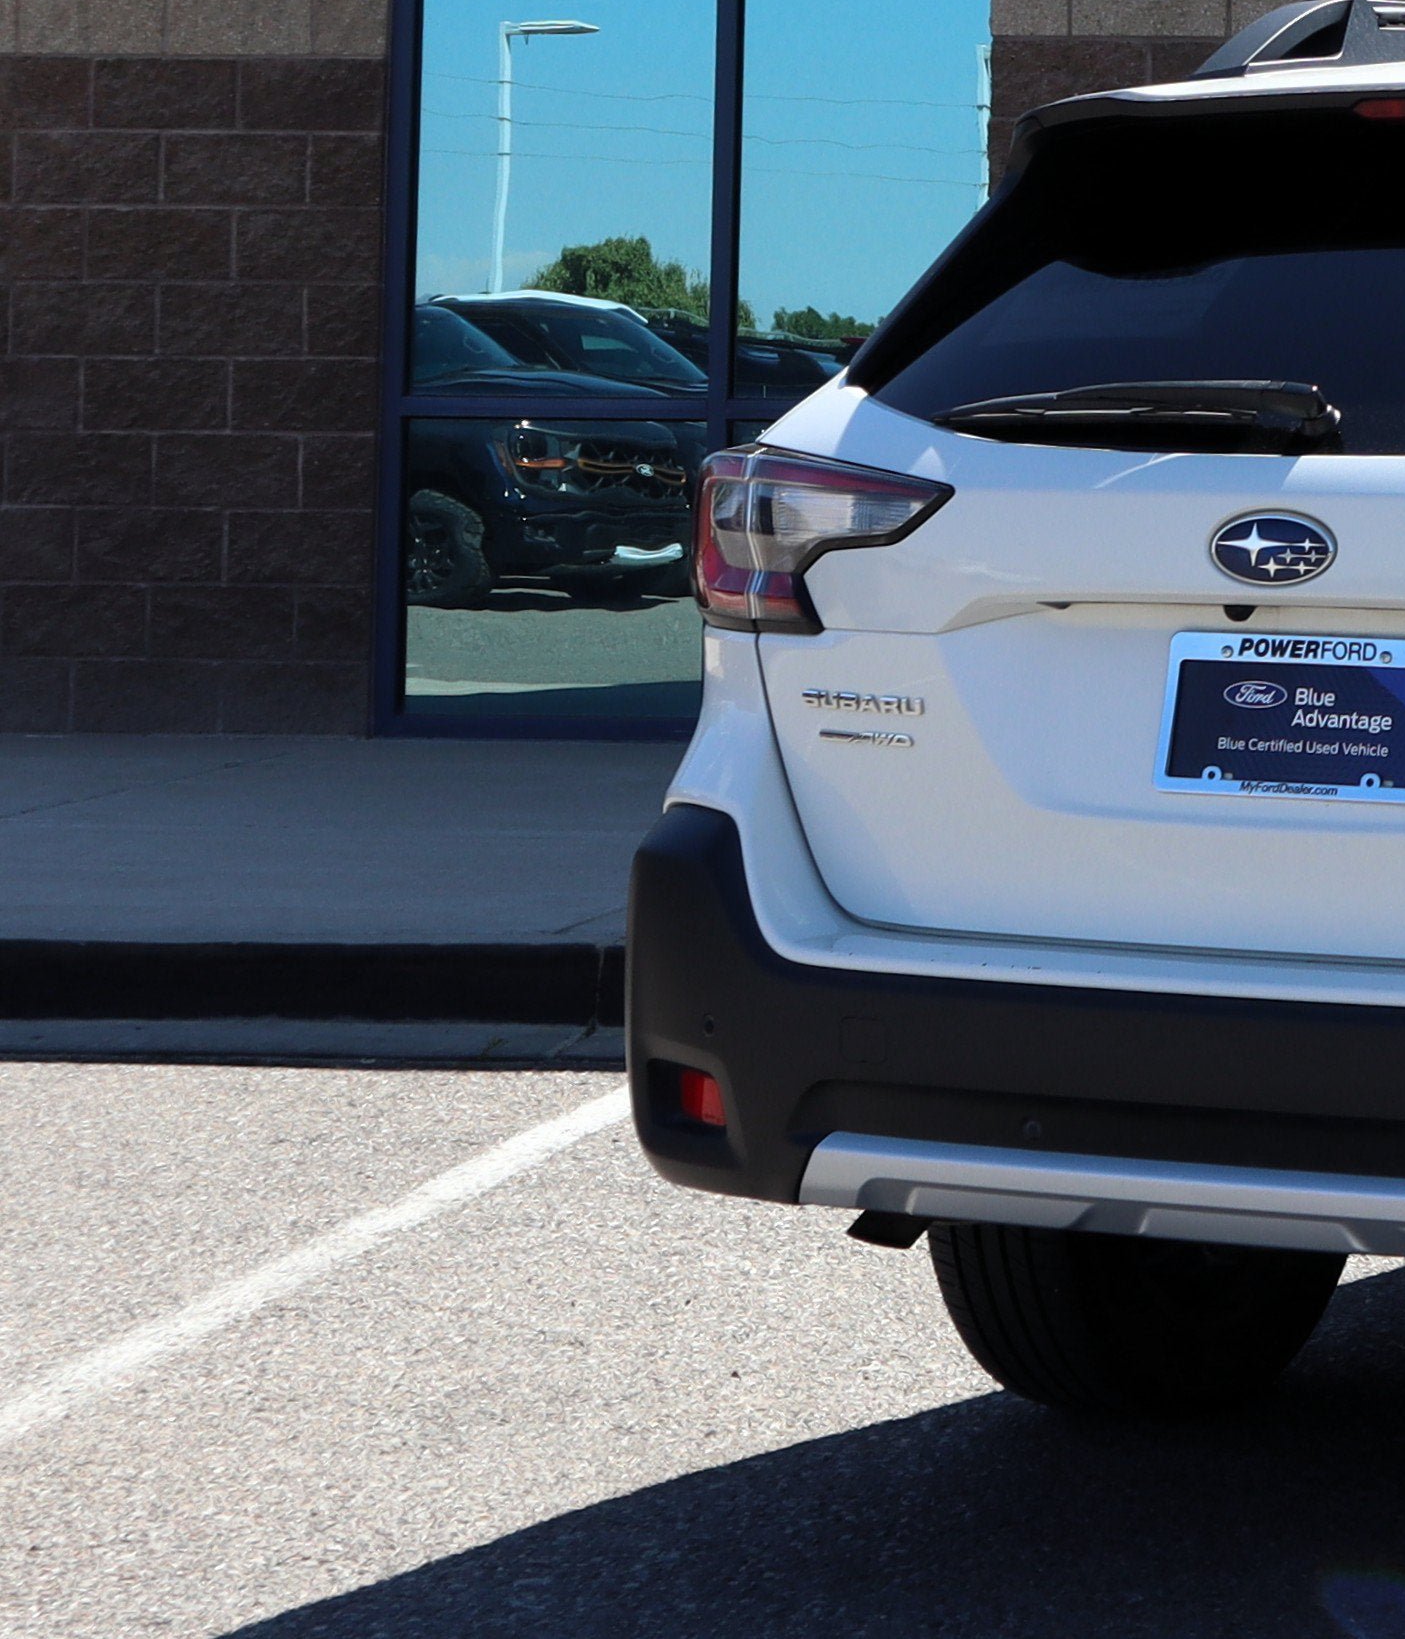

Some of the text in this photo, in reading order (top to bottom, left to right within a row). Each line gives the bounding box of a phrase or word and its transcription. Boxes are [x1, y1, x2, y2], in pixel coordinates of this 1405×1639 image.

[802, 688, 925, 717] SUBARU
[1234, 685, 1275, 705] Ford
[1295, 688, 1336, 707] Blue
[1291, 709, 1393, 734] Advantage
[1217, 736, 1389, 758] Blue Certified Used Vehicle
[1239, 780, 1338, 797] MyFordDealer.com
